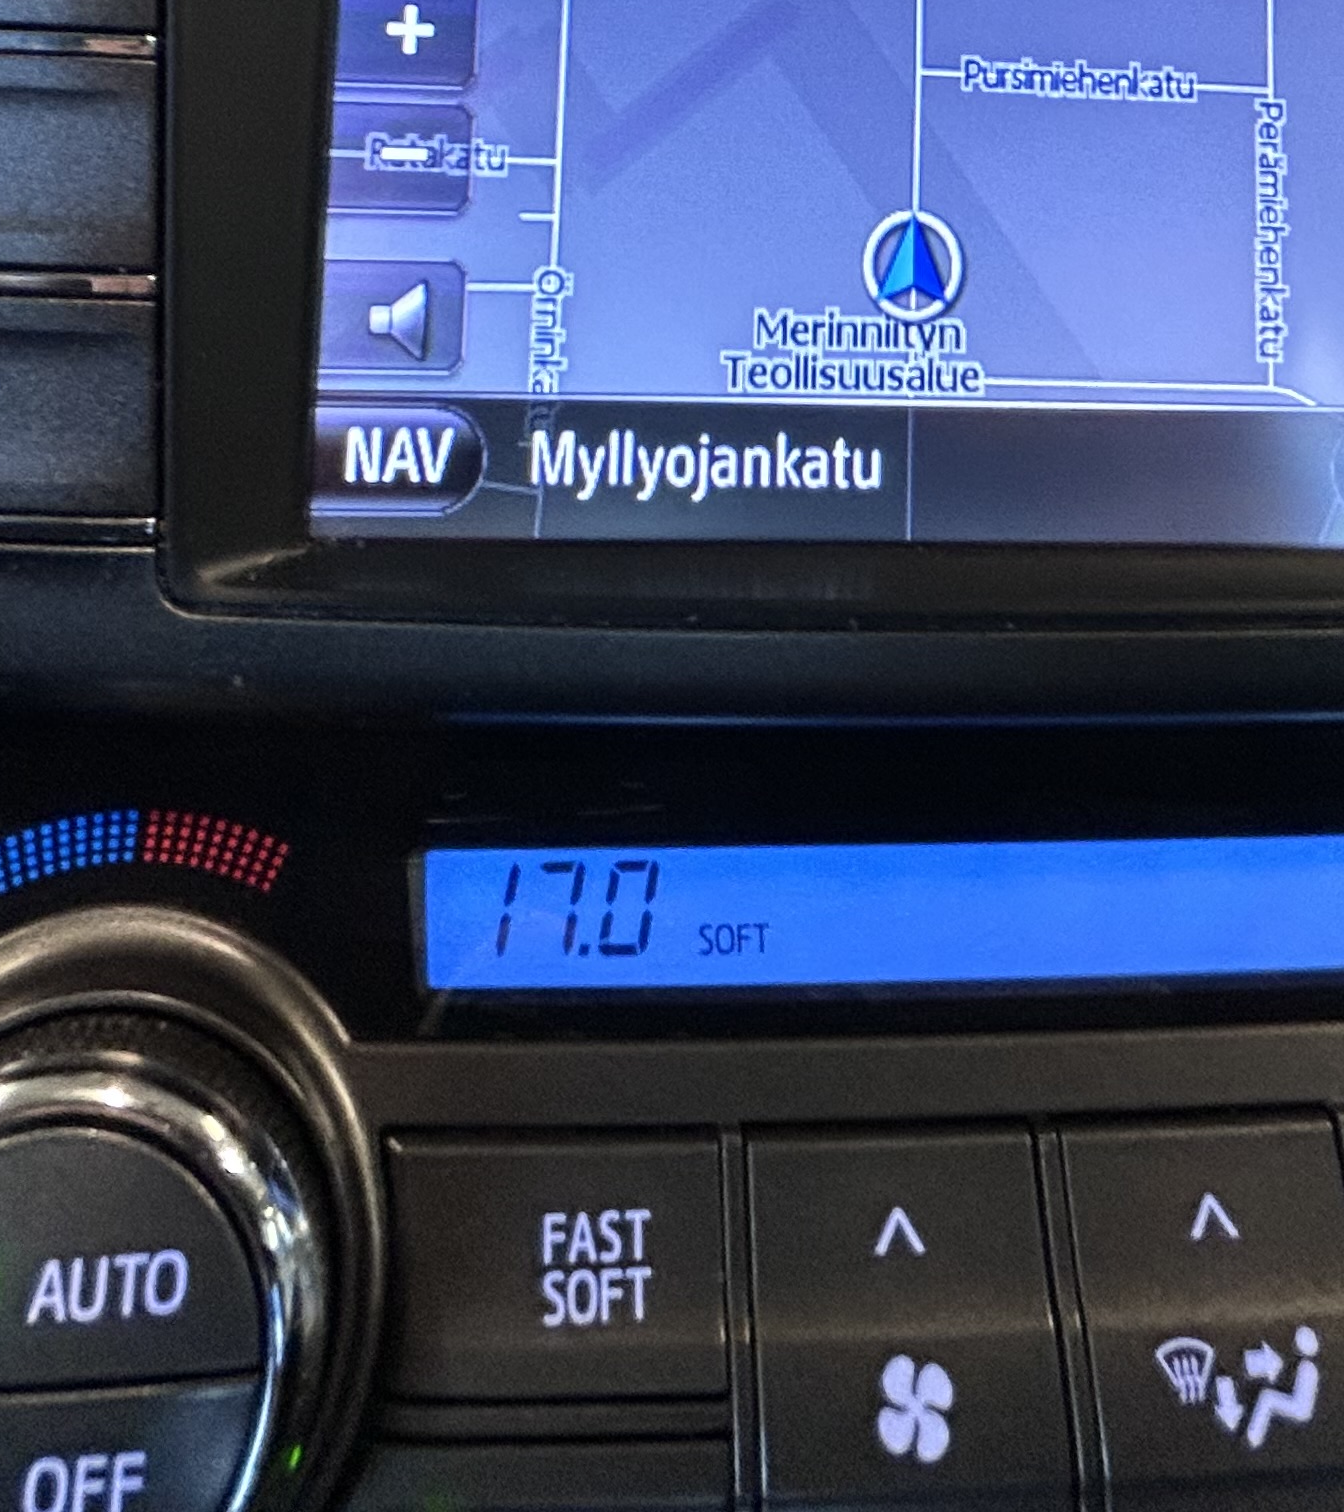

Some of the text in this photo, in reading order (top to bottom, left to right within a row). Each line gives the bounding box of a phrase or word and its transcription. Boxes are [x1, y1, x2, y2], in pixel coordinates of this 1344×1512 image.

[721, 354, 984, 393] Teollisuusalue
[342, 424, 456, 485] NAV
[529, 428, 884, 503] Myllyojankatu
[495, 860, 657, 958] 17.0
[697, 921, 770, 958] SOFT
[541, 1209, 652, 1263] FAST
[25, 1248, 191, 1324] AUTO
[541, 1265, 652, 1327] SOFT
[21, 1450, 148, 1512] OFF
